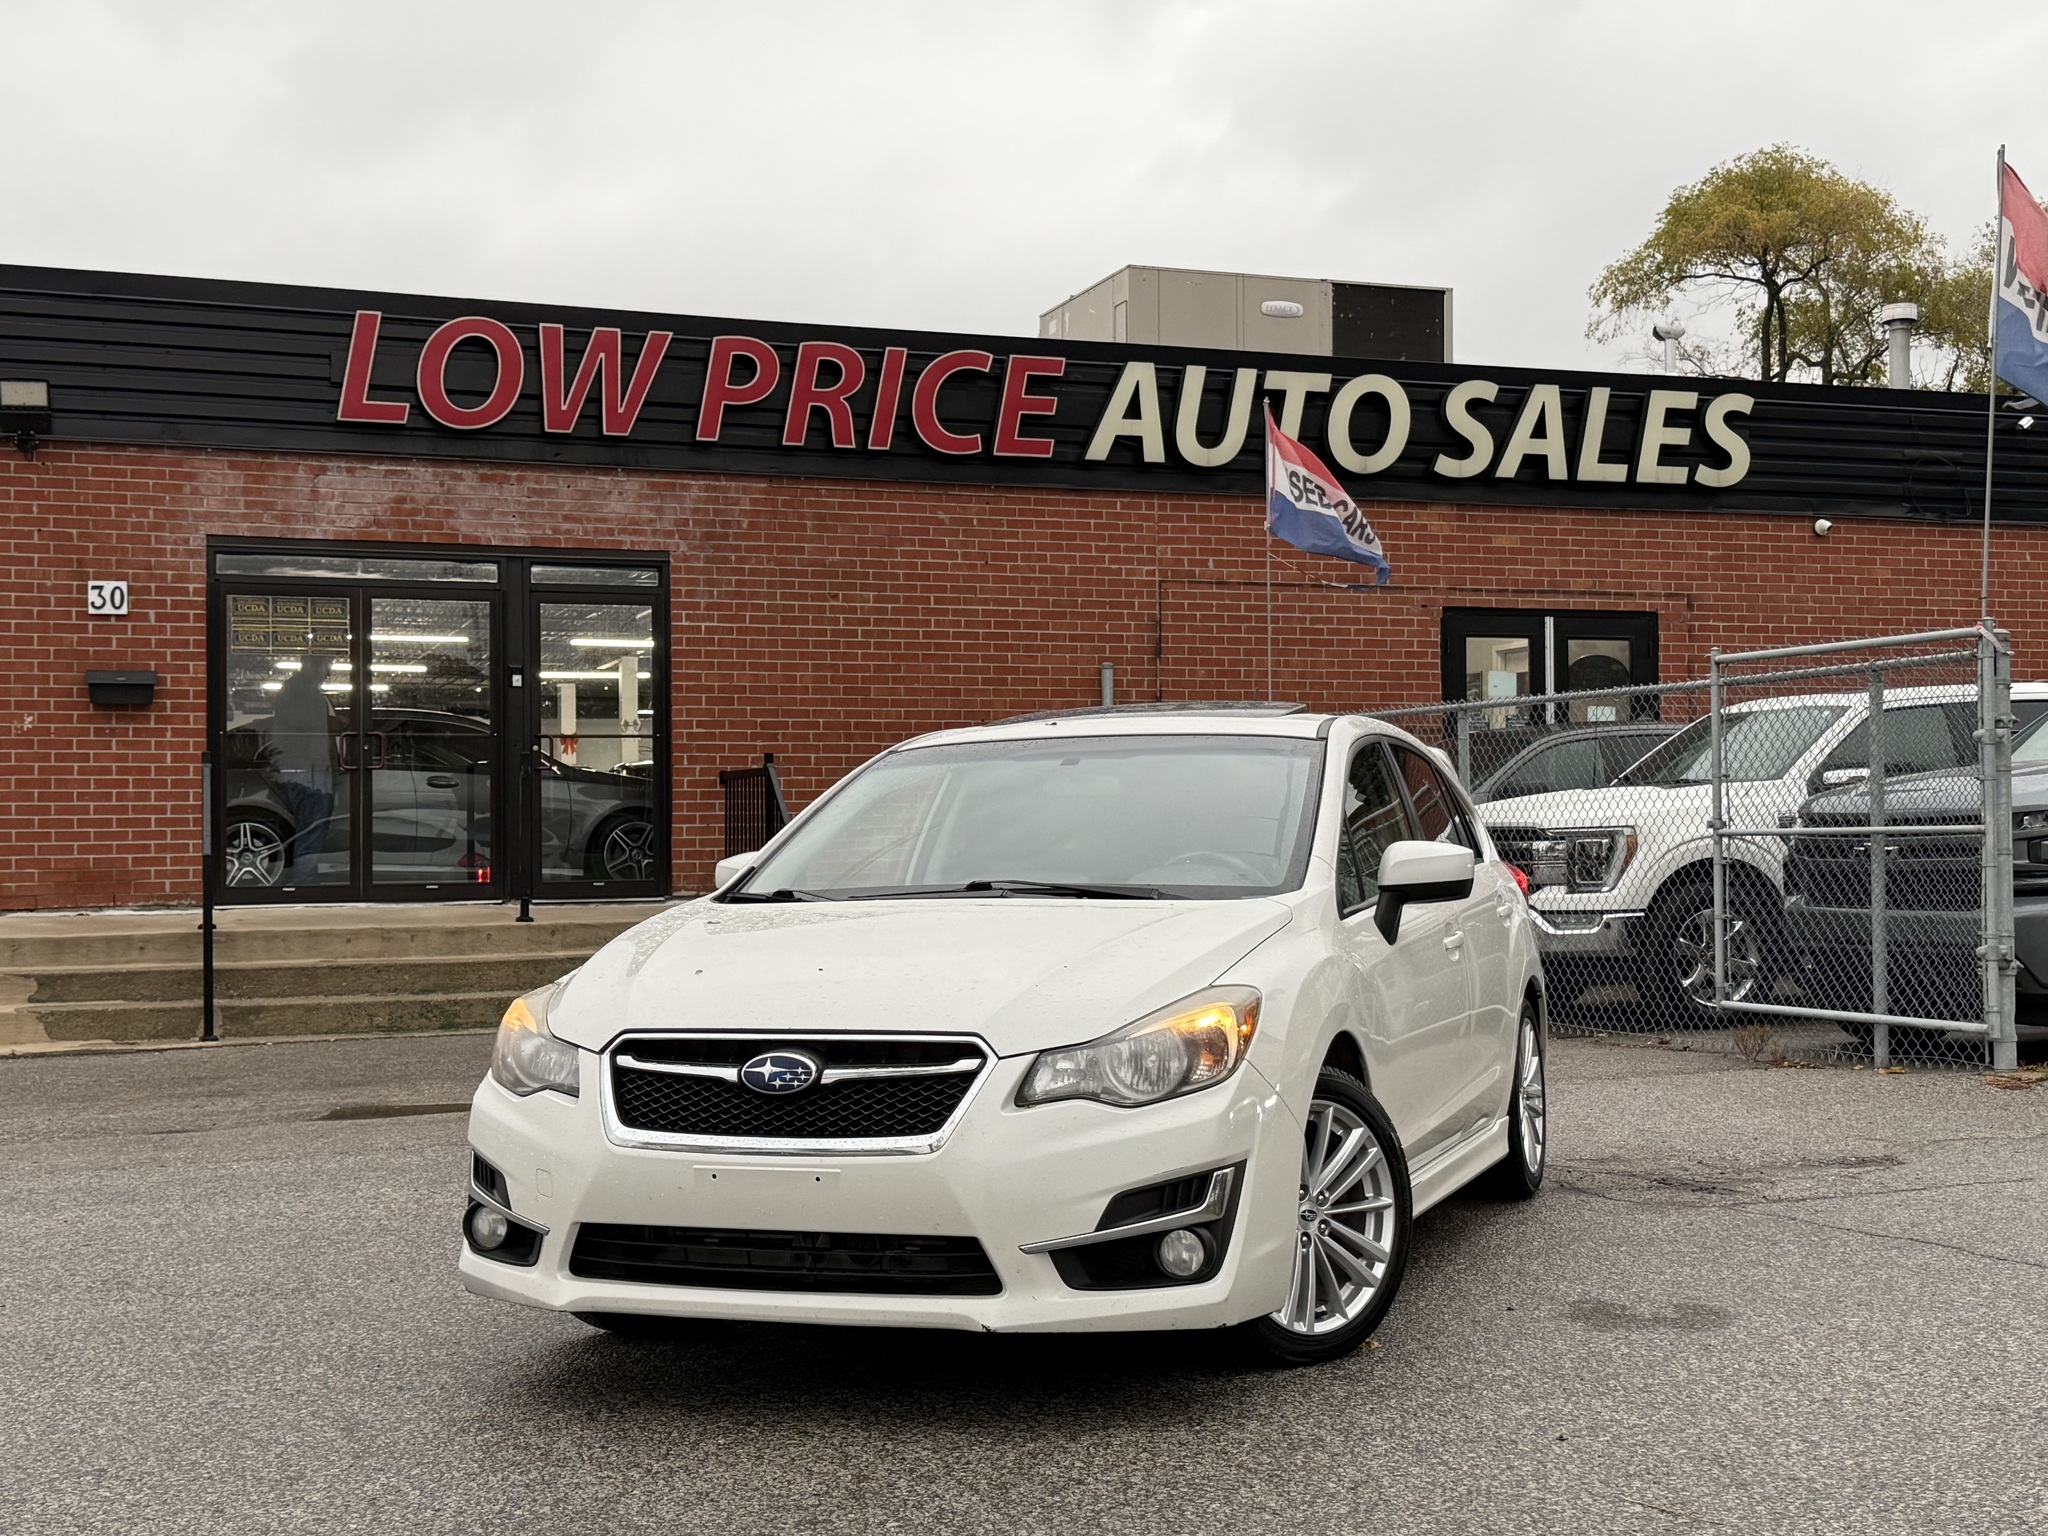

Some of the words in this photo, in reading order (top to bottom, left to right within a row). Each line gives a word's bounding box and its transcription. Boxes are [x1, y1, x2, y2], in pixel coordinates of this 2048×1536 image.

[337, 310, 673, 436] LOW
[696, 335, 1065, 457] PRICE
[1084, 362, 1411, 474] AUTO
[1433, 379, 1755, 488] SALES
[90, 585, 125, 610] 30
[237, 604, 266, 612] UCDA
[276, 605, 304, 614] UCDA
[315, 607, 343, 615] UCDA
[238, 634, 265, 642] UCDA
[277, 634, 304, 643] UCDA
